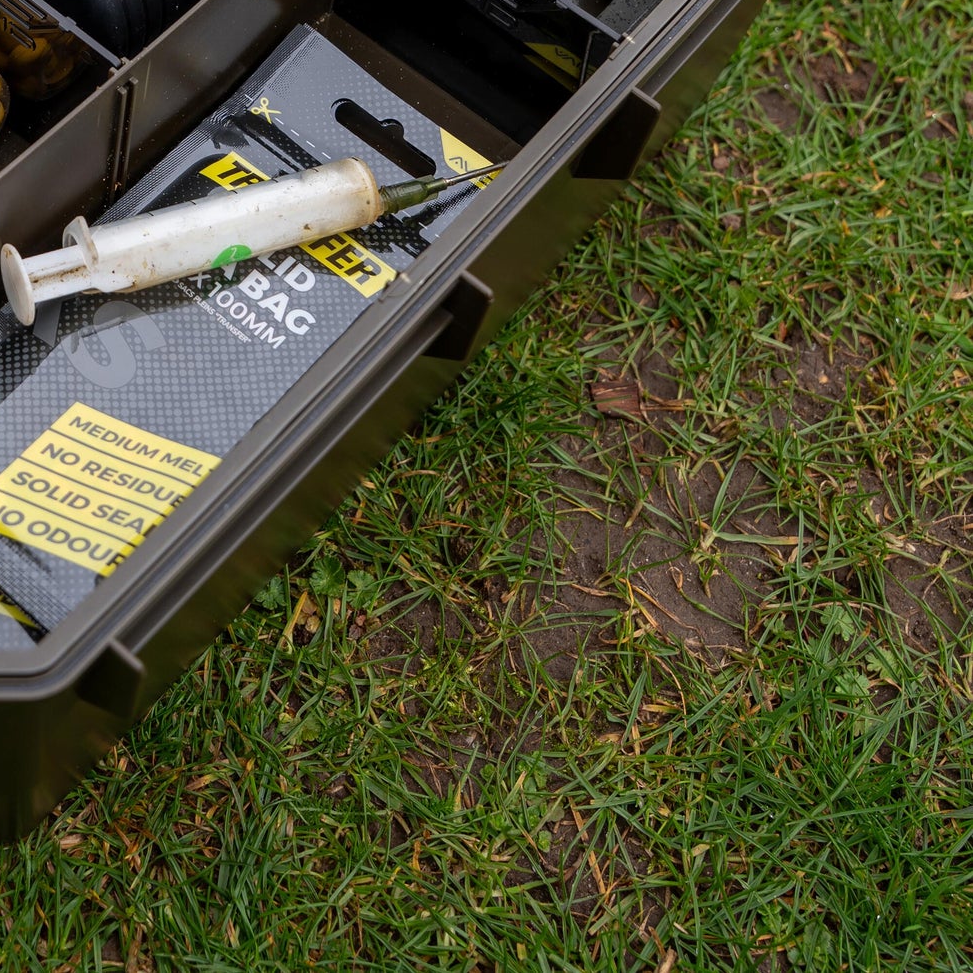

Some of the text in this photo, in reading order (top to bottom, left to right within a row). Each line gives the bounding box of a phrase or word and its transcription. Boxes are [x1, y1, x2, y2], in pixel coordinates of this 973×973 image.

[257, 253, 317, 292] LID
[177, 281, 195, 298] SACS
[192, 294, 215, 316] PLEINS
[208, 280, 288, 349] 100MM
[237, 269, 317, 335] BAG
[40, 442, 81, 466] NO
[68, 416, 215, 477] MEDIUM MEL
[10, 471, 91, 510] SOLID
